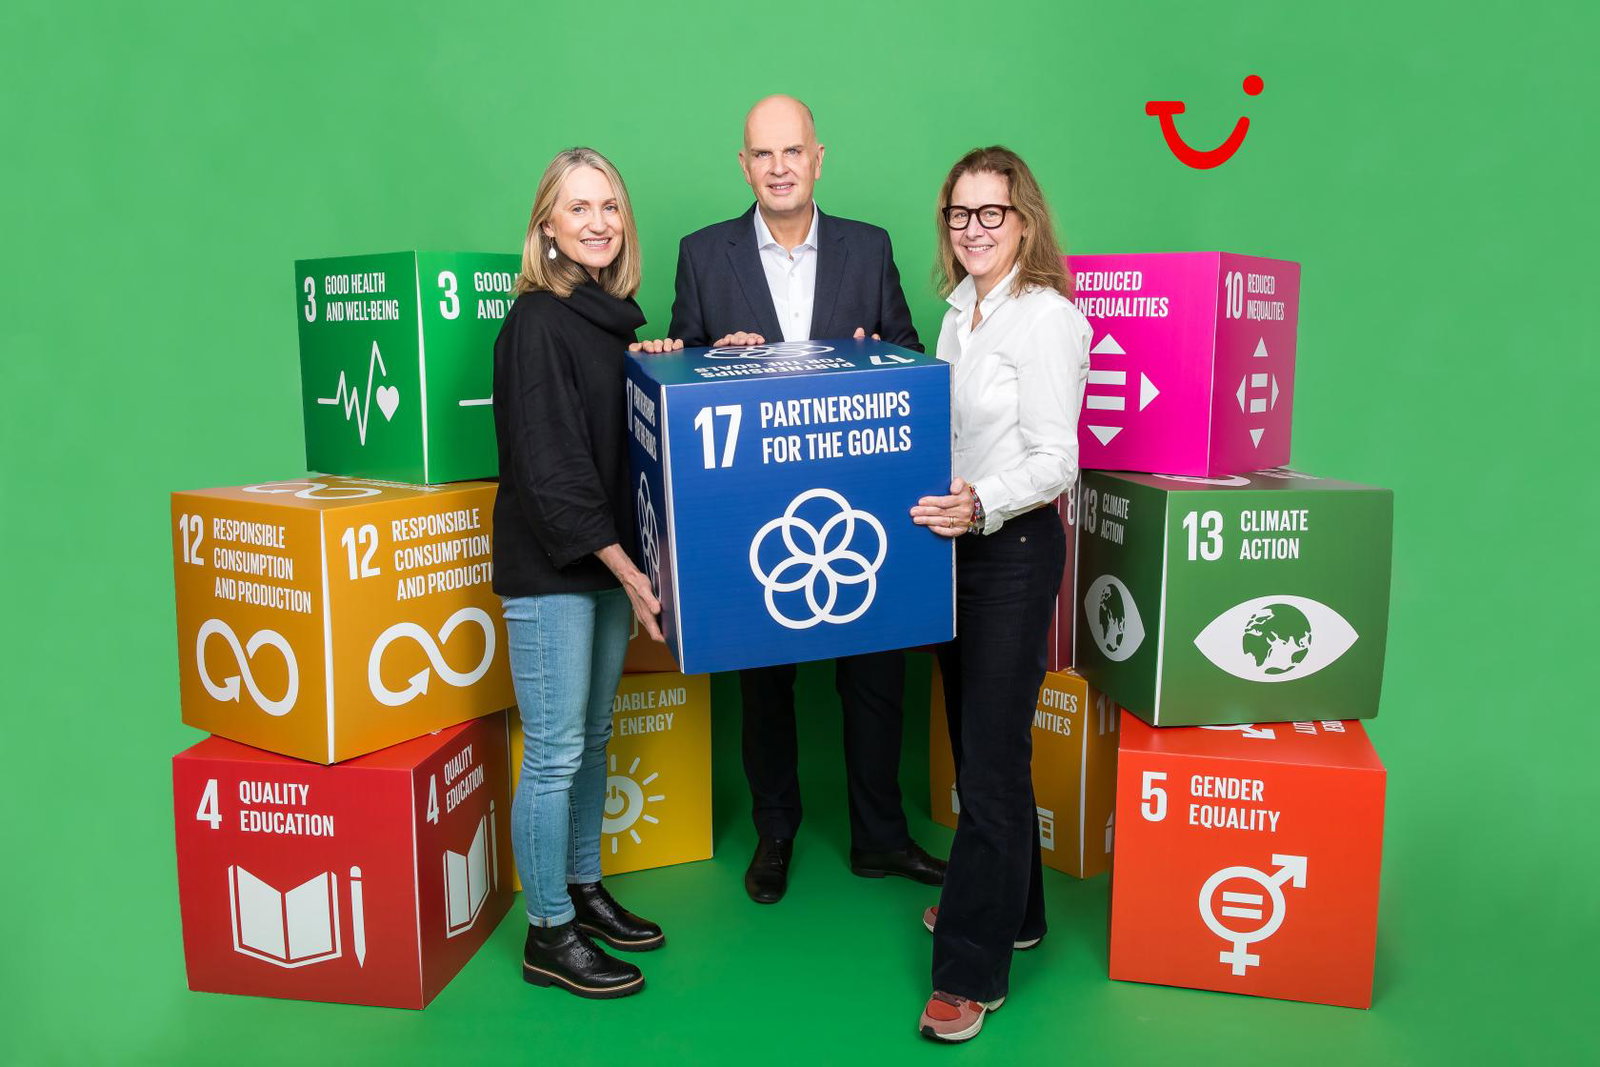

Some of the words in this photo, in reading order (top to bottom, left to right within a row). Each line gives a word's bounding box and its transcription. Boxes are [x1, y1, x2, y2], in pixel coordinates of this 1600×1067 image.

[325, 274, 349, 295] GOOD
[351, 272, 385, 294] HEALTH
[437, 270, 460, 320] 3
[474, 272, 512, 292] GOOD
[1075, 271, 1143, 291] REDUCED
[1225, 271, 1243, 320] 10
[1247, 273, 1275, 295] REDUCED
[304, 276, 317, 322] 3
[326, 301, 344, 322] AND
[345, 299, 399, 321] WELL-BEING
[477, 299, 505, 319] AND
[1247, 300, 1285, 321] INEQUALITIES
[760, 390, 911, 429] PARTNERSHIPS
[694, 403, 743, 470] 17
[762, 435, 802, 464] FOR
[805, 431, 844, 460] THE
[848, 425, 912, 456] GOALS
[1083, 488, 1098, 534] 13
[1102, 492, 1130, 520] CLIMATE
[1240, 509, 1309, 532] CLIMATE
[179, 514, 205, 566] 12
[213, 517, 286, 549] RESPONSIBLE
[391, 508, 481, 542] RESPONSIBLE
[1100, 518, 1125, 546] ACTION
[1182, 510, 1224, 561] 13
[213, 547, 293, 581] CONSUMPTION
[341, 523, 381, 581] 12
[394, 534, 490, 572] CONSUMPTION
[1239, 538, 1299, 560] ACTION
[215, 576, 236, 601] AND
[238, 580, 312, 614] PRODUCTION
[397, 575, 426, 601] AND
[427, 561, 493, 594] PRODUCTI
[612, 690, 656, 713] DABLE
[658, 687, 687, 708] AND
[1042, 687, 1078, 713] CITIES
[620, 712, 674, 737] ENERGY
[1032, 709, 1071, 736] NITIES
[444, 744, 473, 786] QUALITY
[196, 778, 223, 830] 4
[239, 780, 309, 806] QUALITY
[426, 773, 440, 825] 4
[446, 763, 484, 814] EDUCATION
[1141, 771, 1168, 822] 5
[1190, 774, 1265, 802] GENDER
[239, 809, 335, 837] EDUCATION
[1189, 803, 1281, 832] EQUALITY
